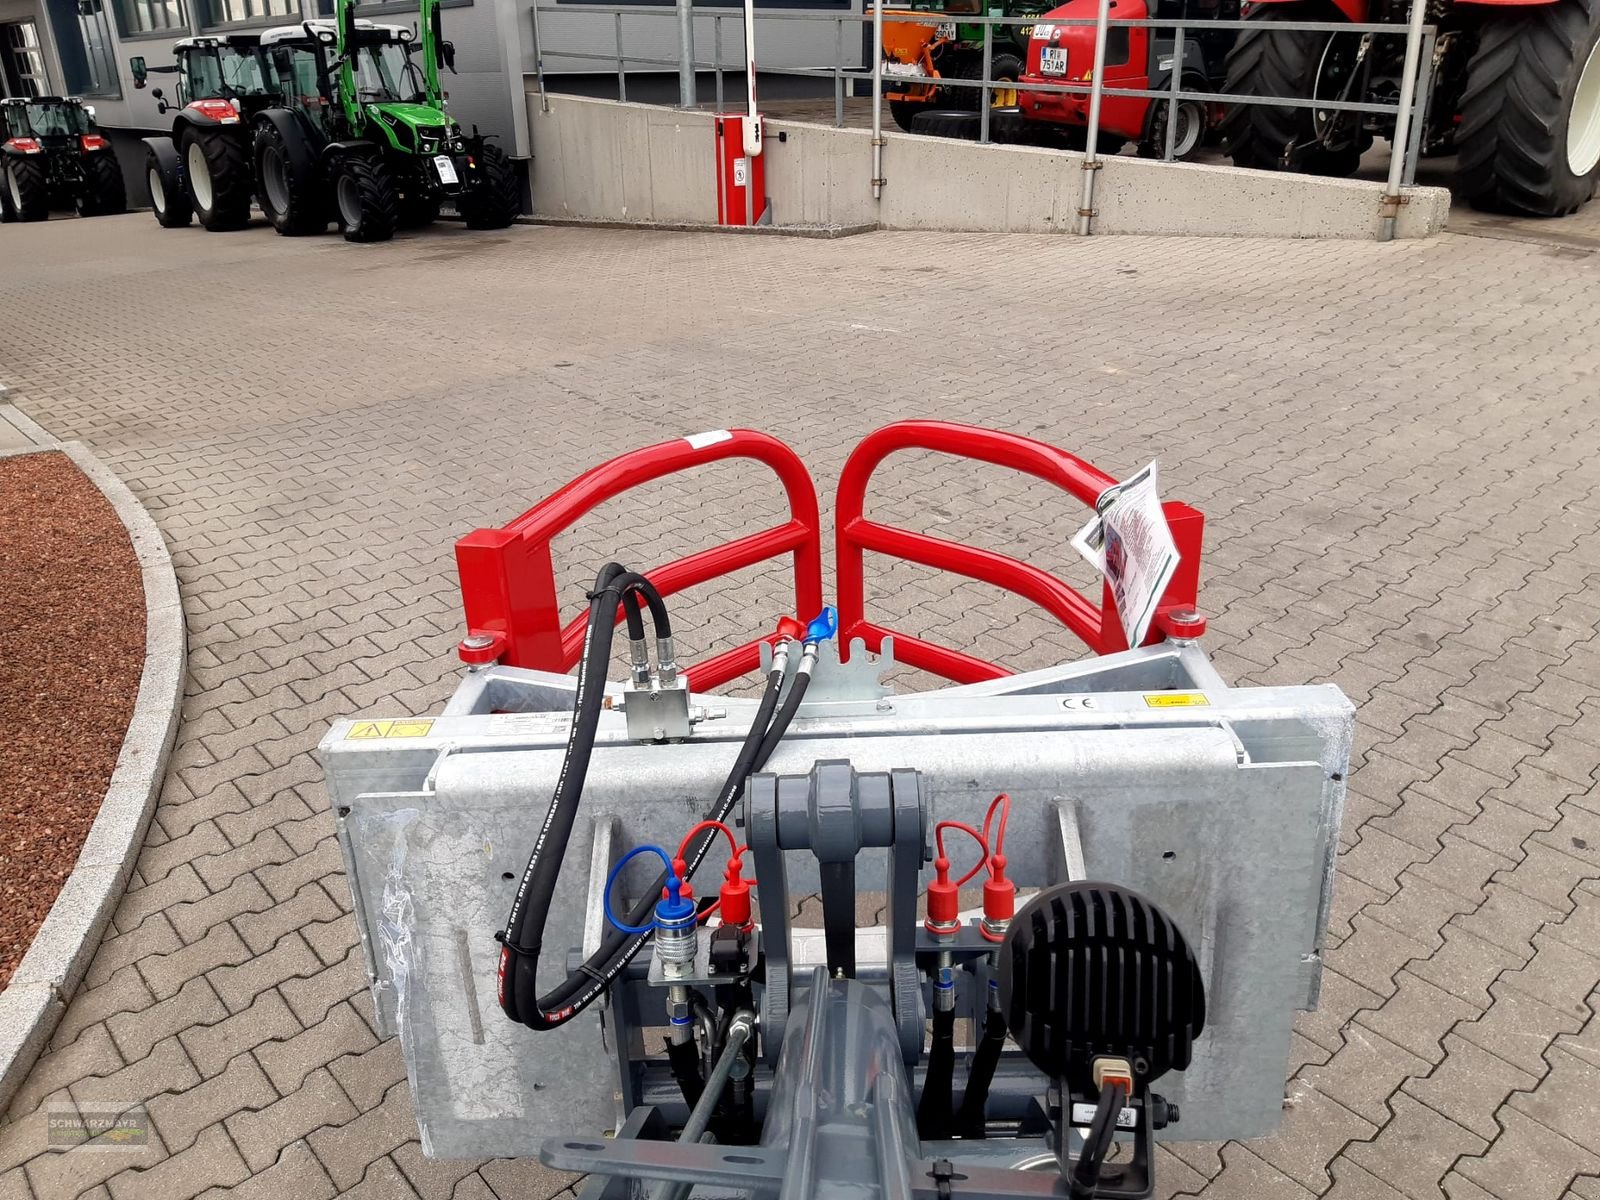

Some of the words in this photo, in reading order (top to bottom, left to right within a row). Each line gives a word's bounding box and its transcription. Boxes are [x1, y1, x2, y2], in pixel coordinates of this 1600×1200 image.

[510, 902, 520, 924] DN10
[518, 882, 527, 898] DIN
[524, 870, 532, 882] EN
[536, 834, 546, 850] SAE
